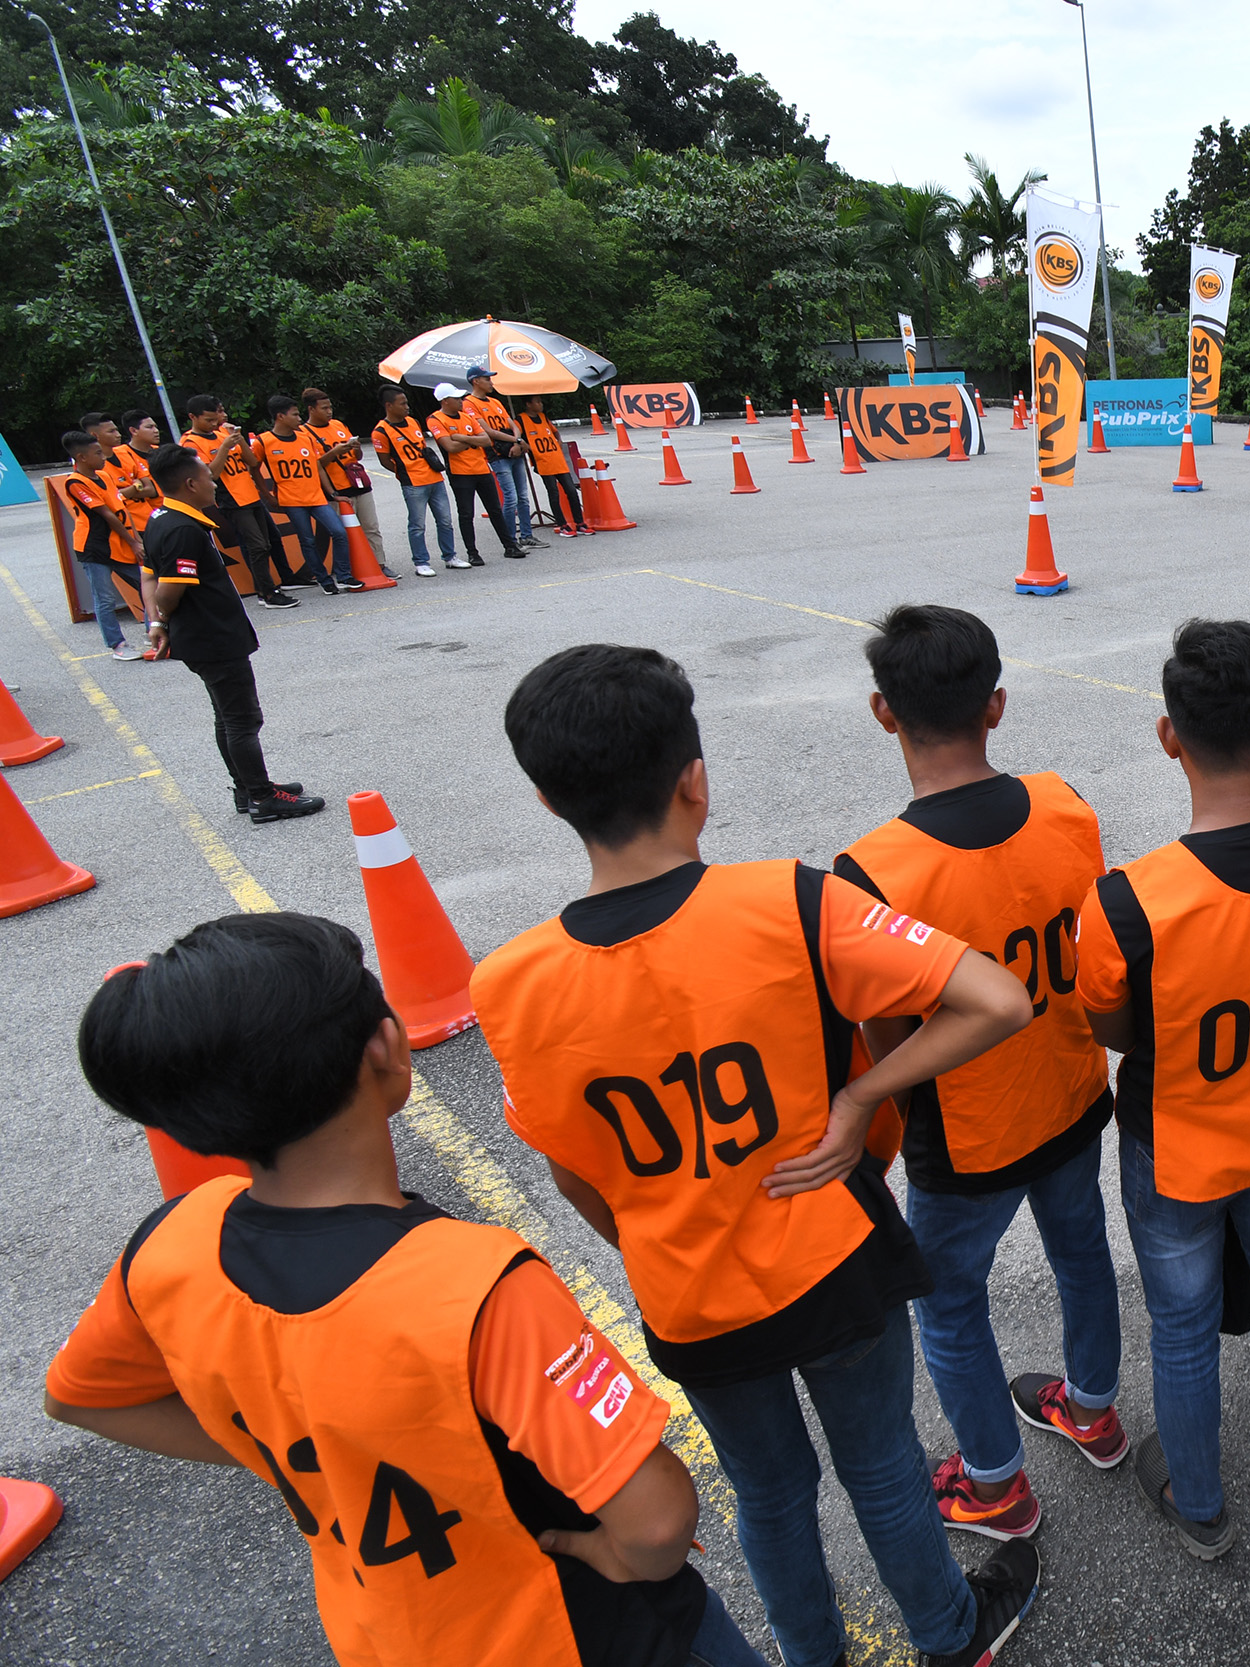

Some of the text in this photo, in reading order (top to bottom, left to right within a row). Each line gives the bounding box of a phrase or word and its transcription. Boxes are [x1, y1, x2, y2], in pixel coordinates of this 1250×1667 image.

[1046, 254, 1074, 271] KBS
[1201, 281, 1219, 291] KBS
[513, 353, 531, 361] KBS
[1191, 336, 1212, 395] KBS
[623, 392, 684, 418] KBS
[1093, 400, 1163, 411] PETRONAS
[865, 401, 952, 445] KBS
[1099, 412, 1180, 426] CubPrix
[278, 458, 313, 479] 026
[979, 907, 1078, 1019] 20
[583, 1041, 780, 1180] 019
[586, 1357, 610, 1388] HONDA
